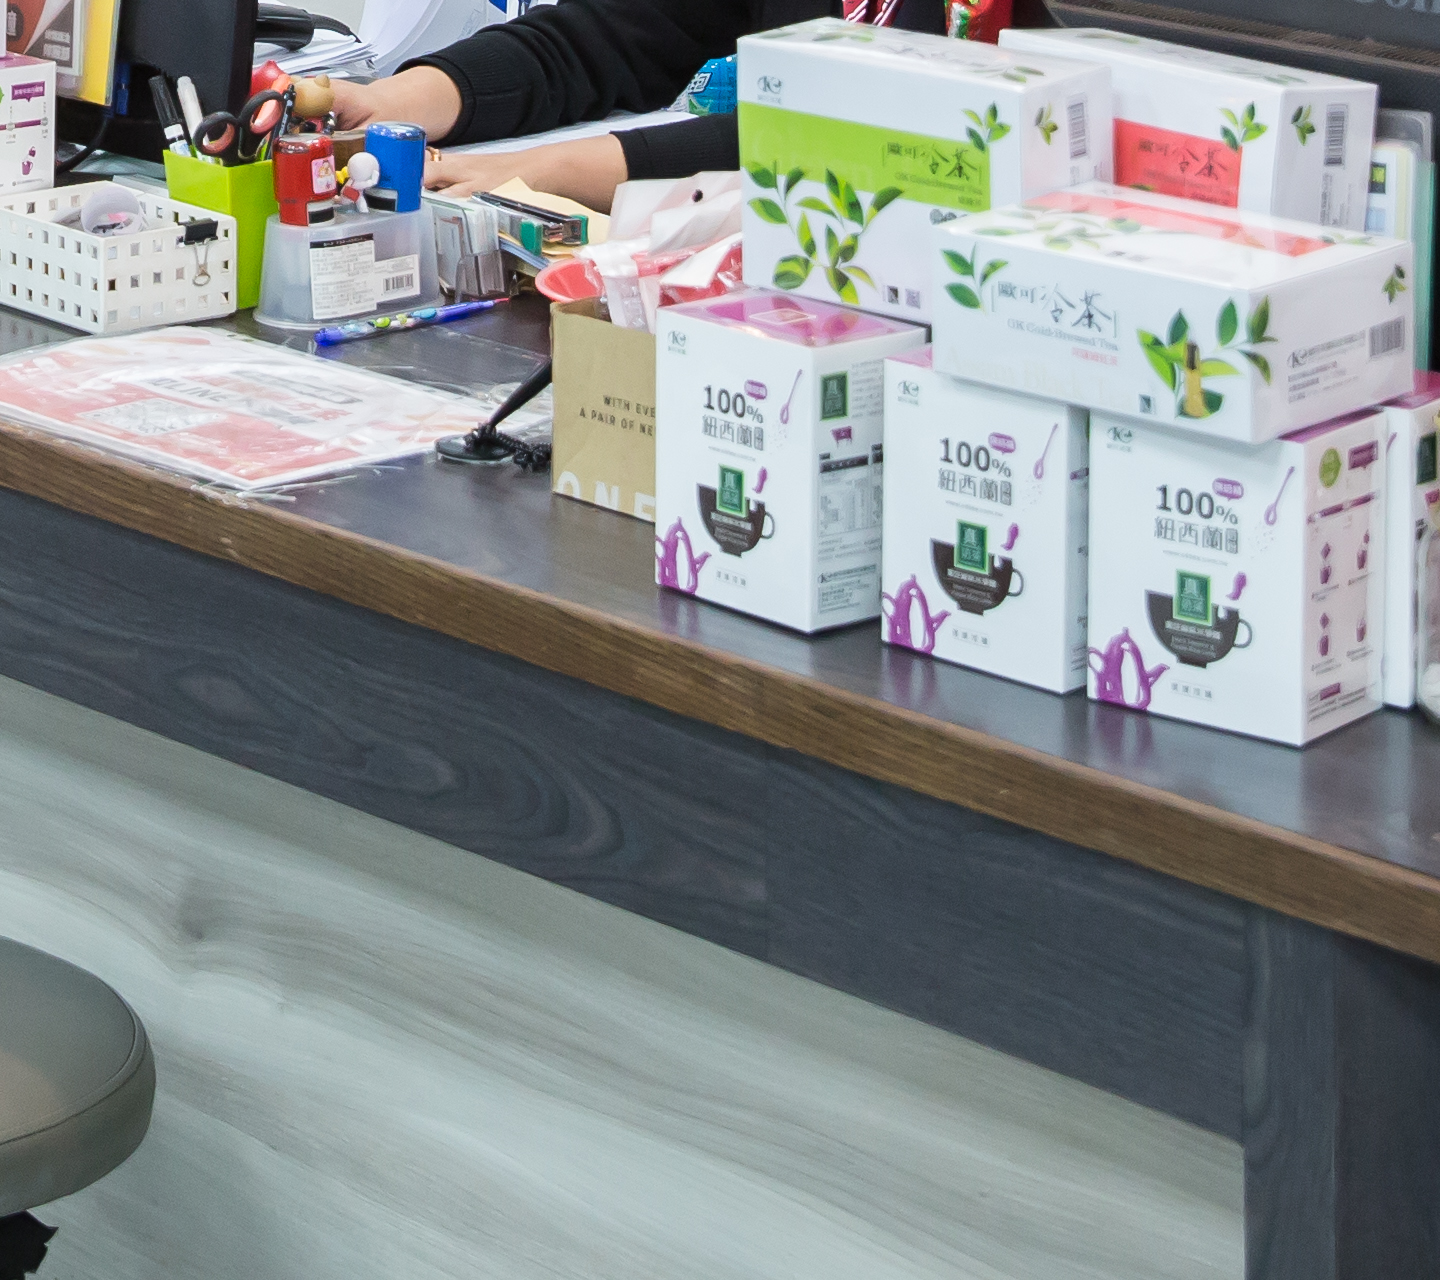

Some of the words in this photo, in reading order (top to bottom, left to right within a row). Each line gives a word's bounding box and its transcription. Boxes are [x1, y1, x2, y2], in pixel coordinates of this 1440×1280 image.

[886, 141, 978, 181] 歐可冷茶
[997, 280, 1112, 334] 歐可冷茶
[702, 385, 764, 425] 100%
[939, 437, 1012, 478] 100%
[1155, 484, 1239, 525] 100%
